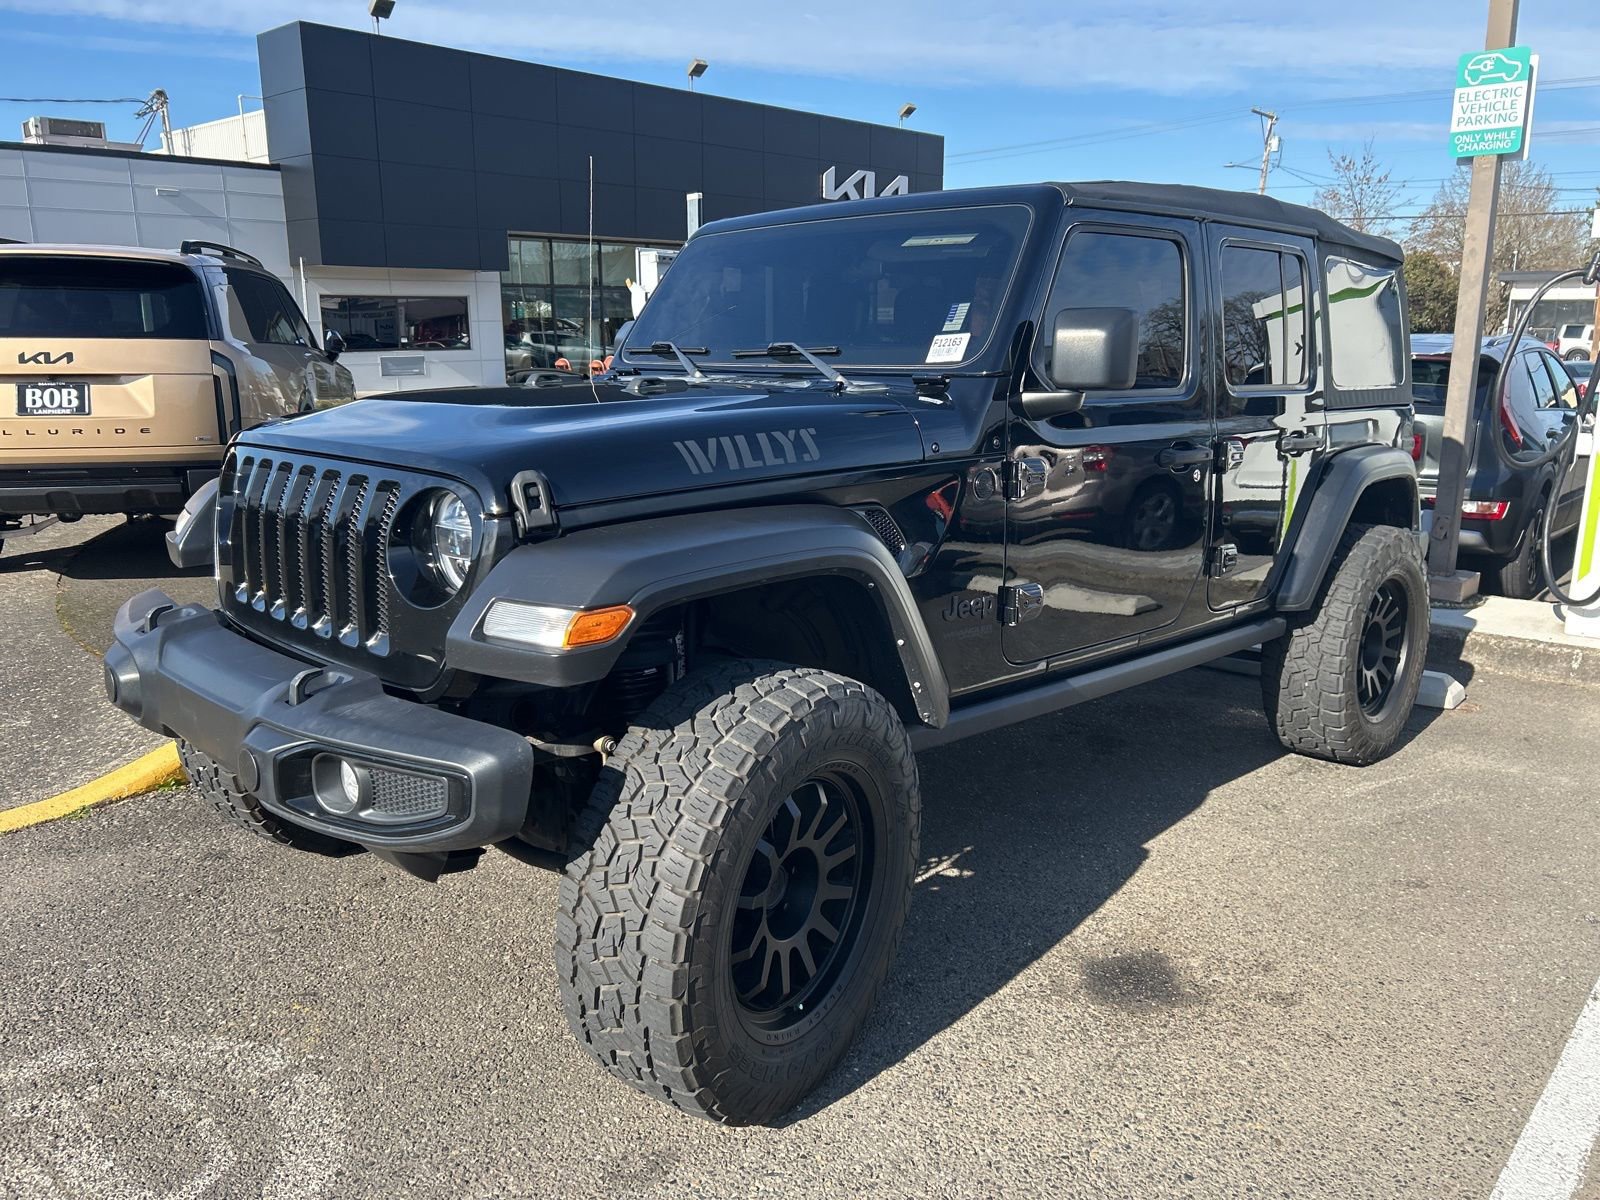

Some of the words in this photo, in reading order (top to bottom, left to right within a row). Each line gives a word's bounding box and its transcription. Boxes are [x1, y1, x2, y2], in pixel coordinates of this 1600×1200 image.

[1458, 86, 1523, 104] ELECTRIC
[1460, 99, 1518, 115] VEHICLE
[1456, 111, 1519, 127] PARKING
[1454, 133, 1481, 144] ONLY
[1484, 129, 1517, 140] WHILE
[1456, 139, 1512, 152] CHARGING
[823, 165, 908, 200] KIA
[932, 337, 963, 348] F12163
[18, 351, 74, 365] KIA
[25, 388, 79, 408] BOB
[2, 427, 151, 436] LLURIDE
[673, 427, 820, 475] WILLYS
[941, 595, 993, 621] Jeep
[808, 983, 844, 1026] BLACK
